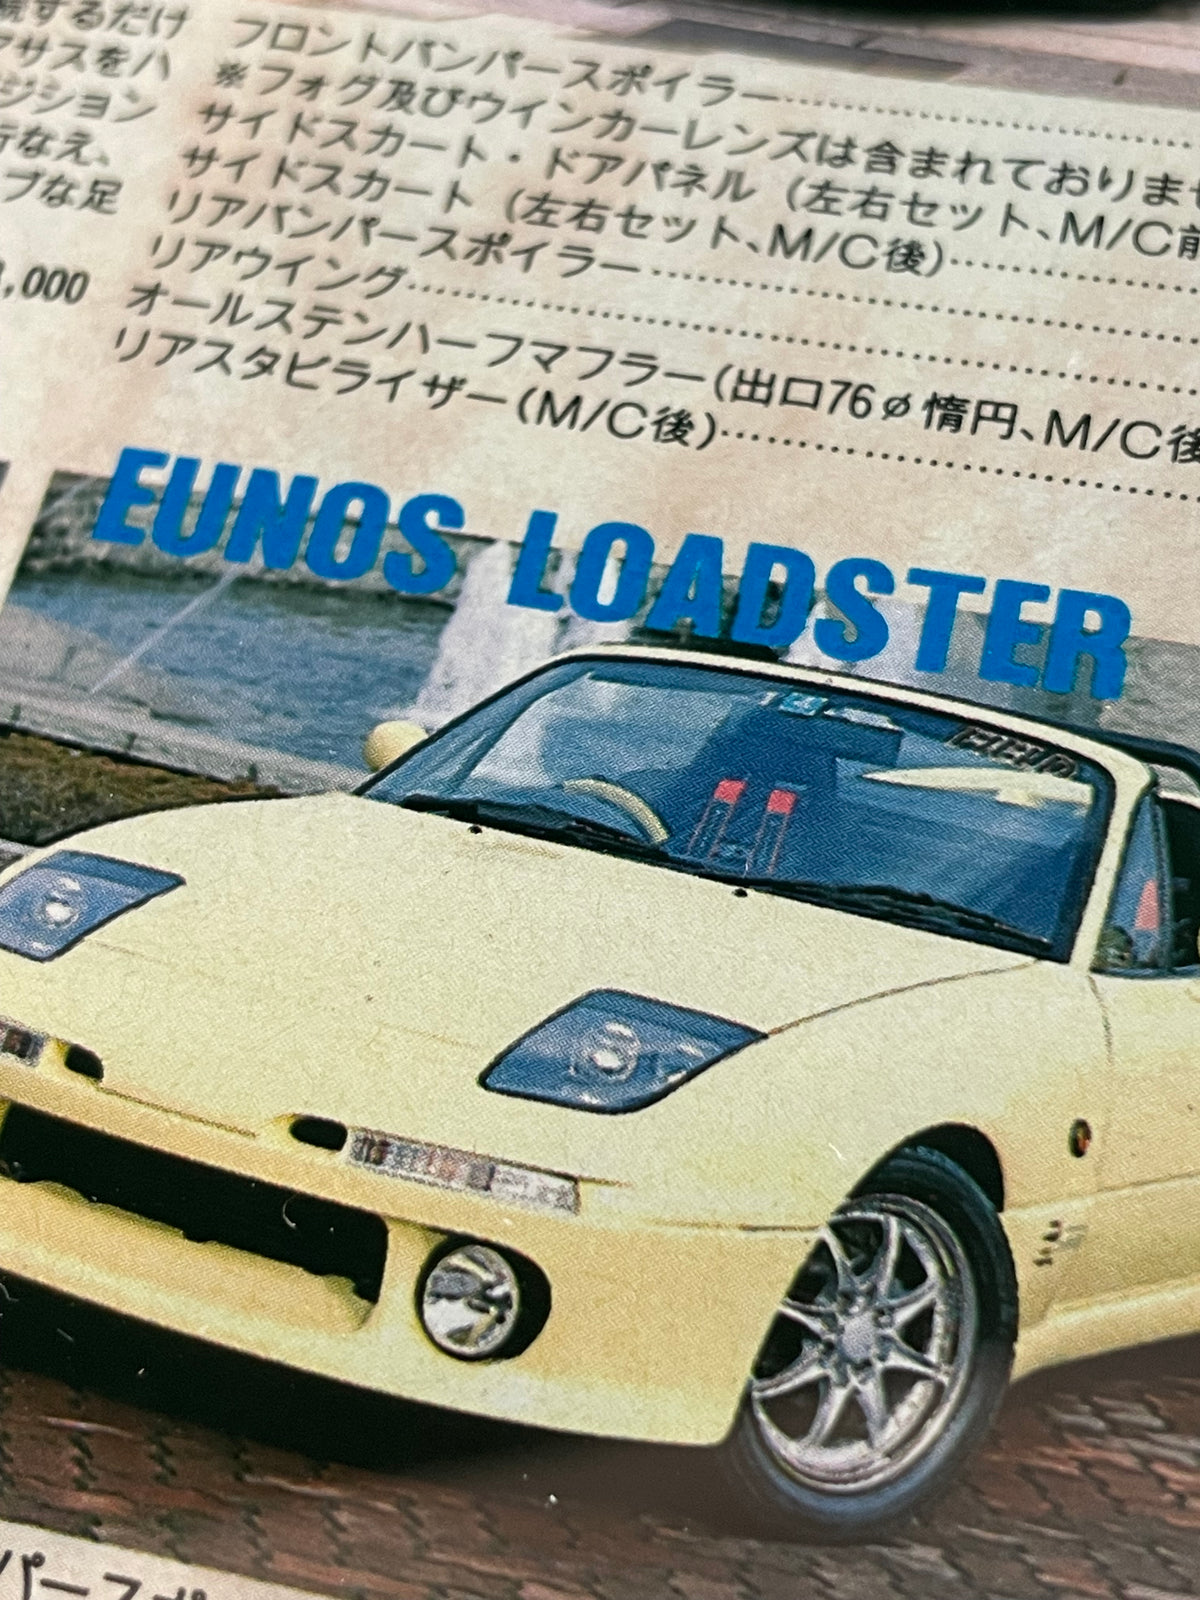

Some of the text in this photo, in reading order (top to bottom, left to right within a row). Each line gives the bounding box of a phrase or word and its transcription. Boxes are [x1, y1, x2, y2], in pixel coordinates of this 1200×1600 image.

[214, 61, 1200, 210] ※フォグ及びウインカーレンズは含まれておりま
[0, 259, 90, 304] ,000
[151, 235, 409, 300] リアウイング
[92, 446, 1132, 702] EUNOS LOADSTER
